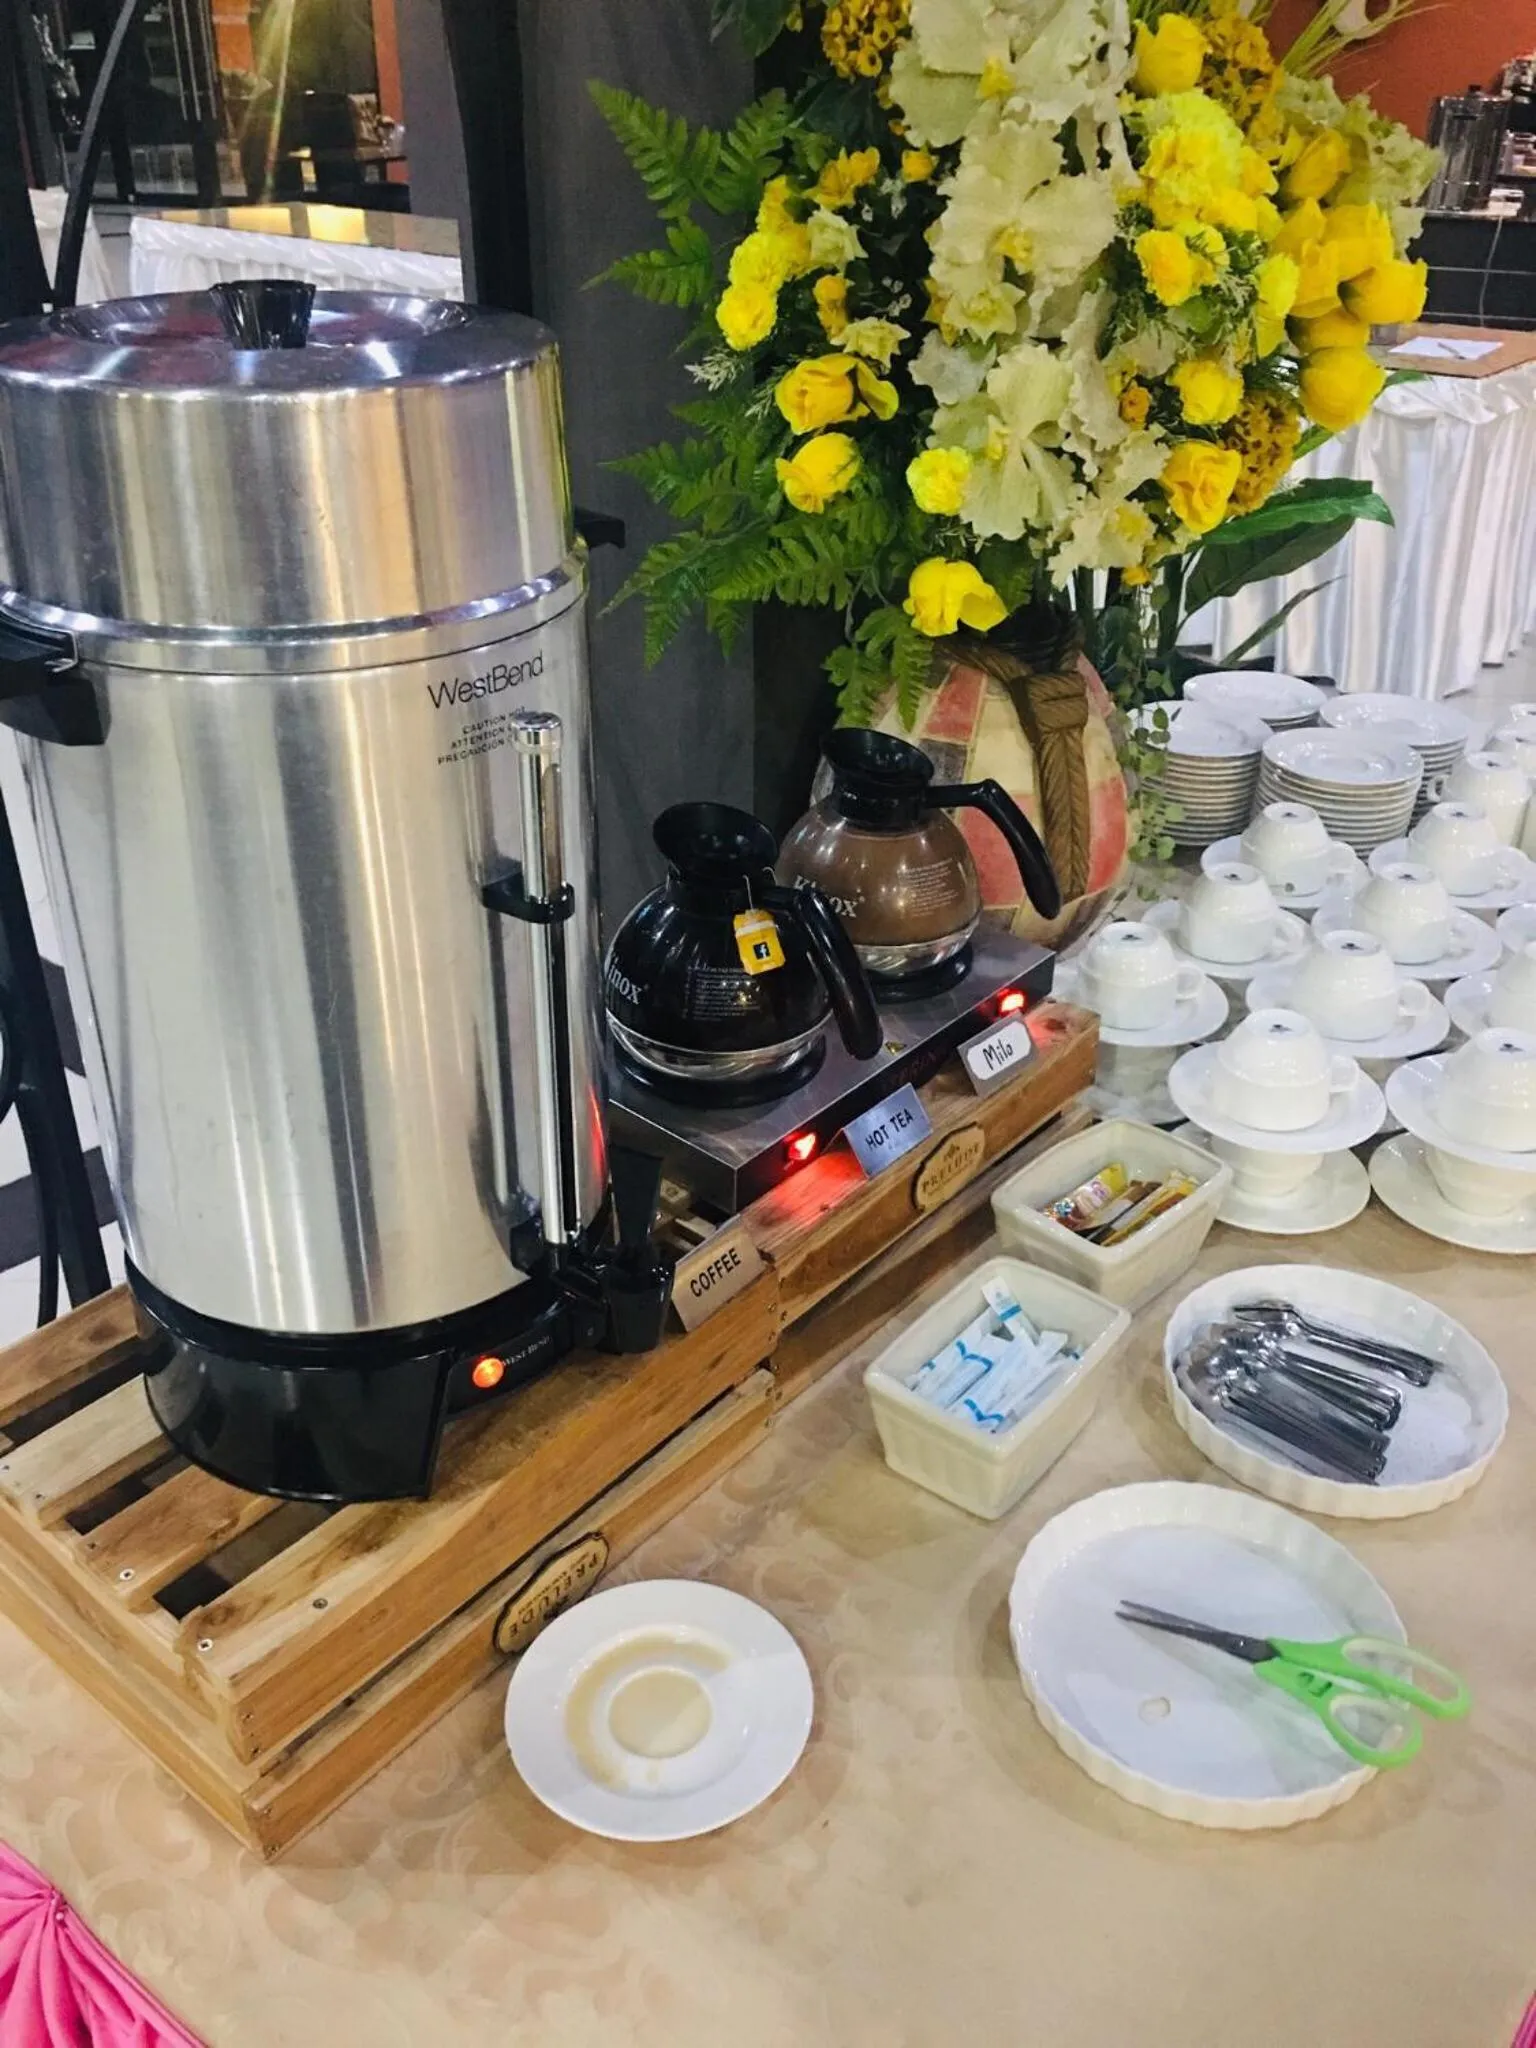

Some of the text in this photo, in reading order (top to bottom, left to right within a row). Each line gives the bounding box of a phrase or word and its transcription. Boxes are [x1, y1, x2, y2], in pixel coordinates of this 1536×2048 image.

[427, 649, 544, 709] WestBend
[451, 726, 505, 749] ATTENTION
[463, 714, 506, 734] CAUTION
[606, 956, 643, 1005] inox
[982, 1038, 1014, 1071] Milo
[865, 1107, 914, 1150] HOT TEA
[689, 1247, 742, 1299] COFFEE
[509, 1552, 598, 1638] PRELUDE
